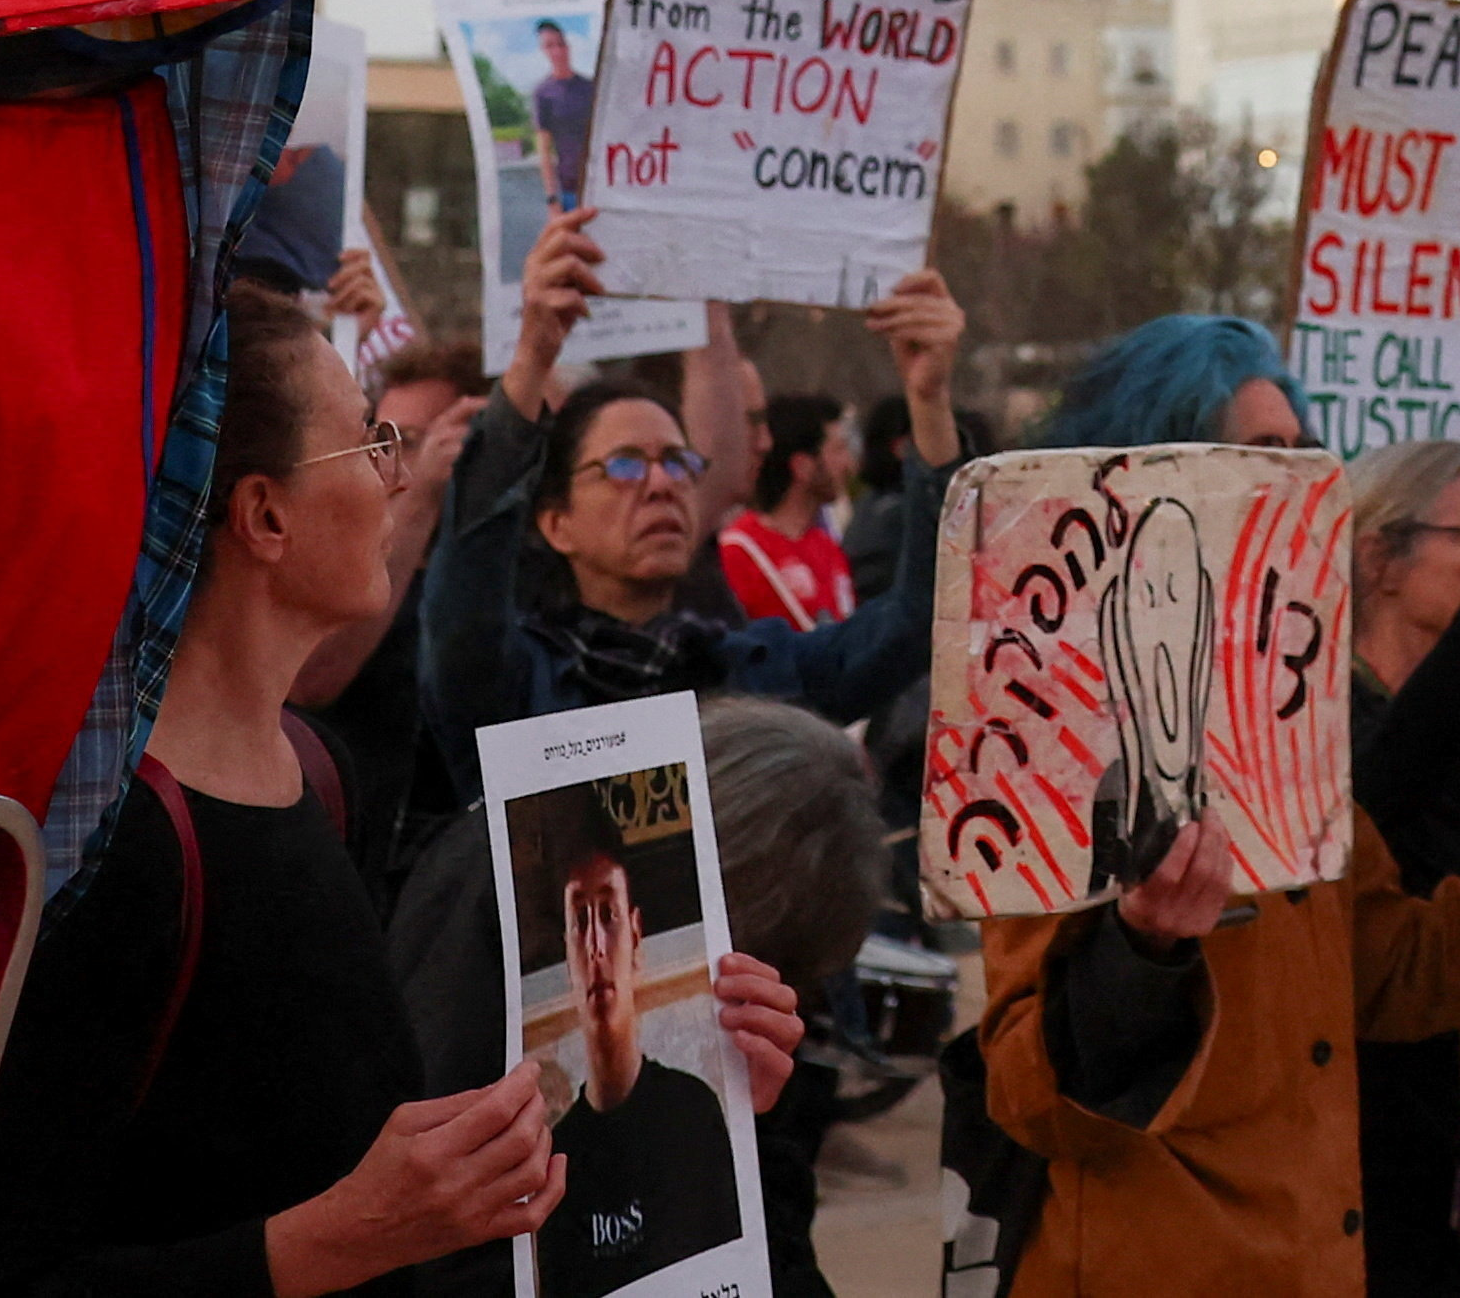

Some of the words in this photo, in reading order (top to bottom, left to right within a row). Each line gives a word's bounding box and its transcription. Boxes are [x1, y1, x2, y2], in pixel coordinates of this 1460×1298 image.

[644, 41, 880, 126] ACTION
[605, 127, 681, 188] not
[1311, 124, 1457, 217] MUST
[1295, 321, 1363, 387] THE
[1372, 329, 1454, 392] CALL
